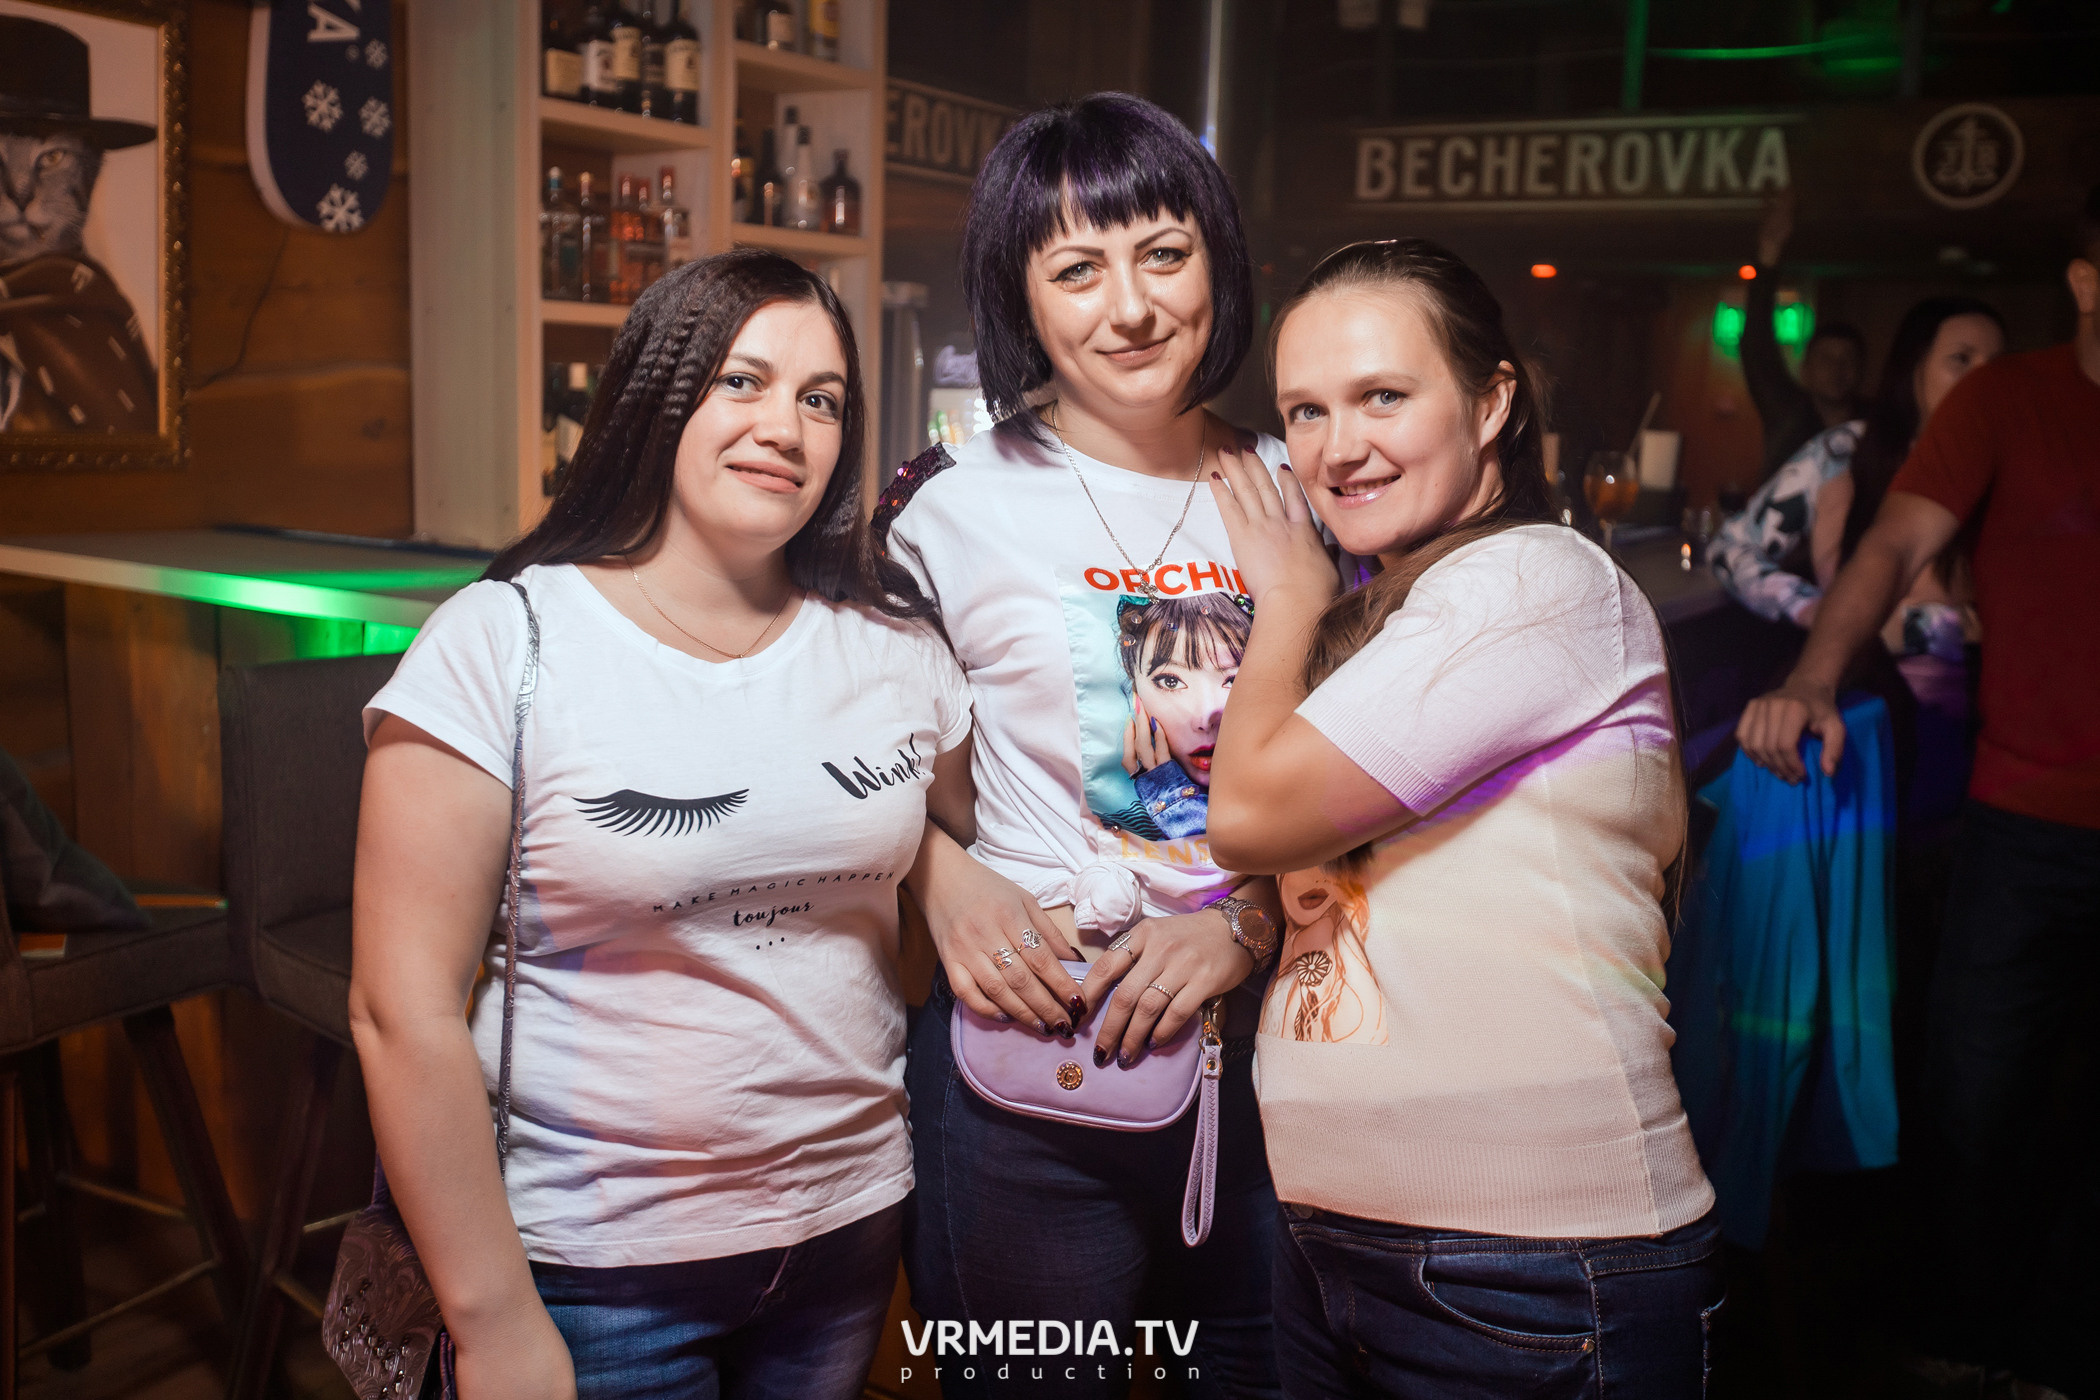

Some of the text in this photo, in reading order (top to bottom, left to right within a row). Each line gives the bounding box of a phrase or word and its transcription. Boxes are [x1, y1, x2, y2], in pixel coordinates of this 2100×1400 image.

[1355, 127, 1791, 199] BECHEROVKA
[653, 871, 895, 913] MAKE MAGIC HAPPEN
